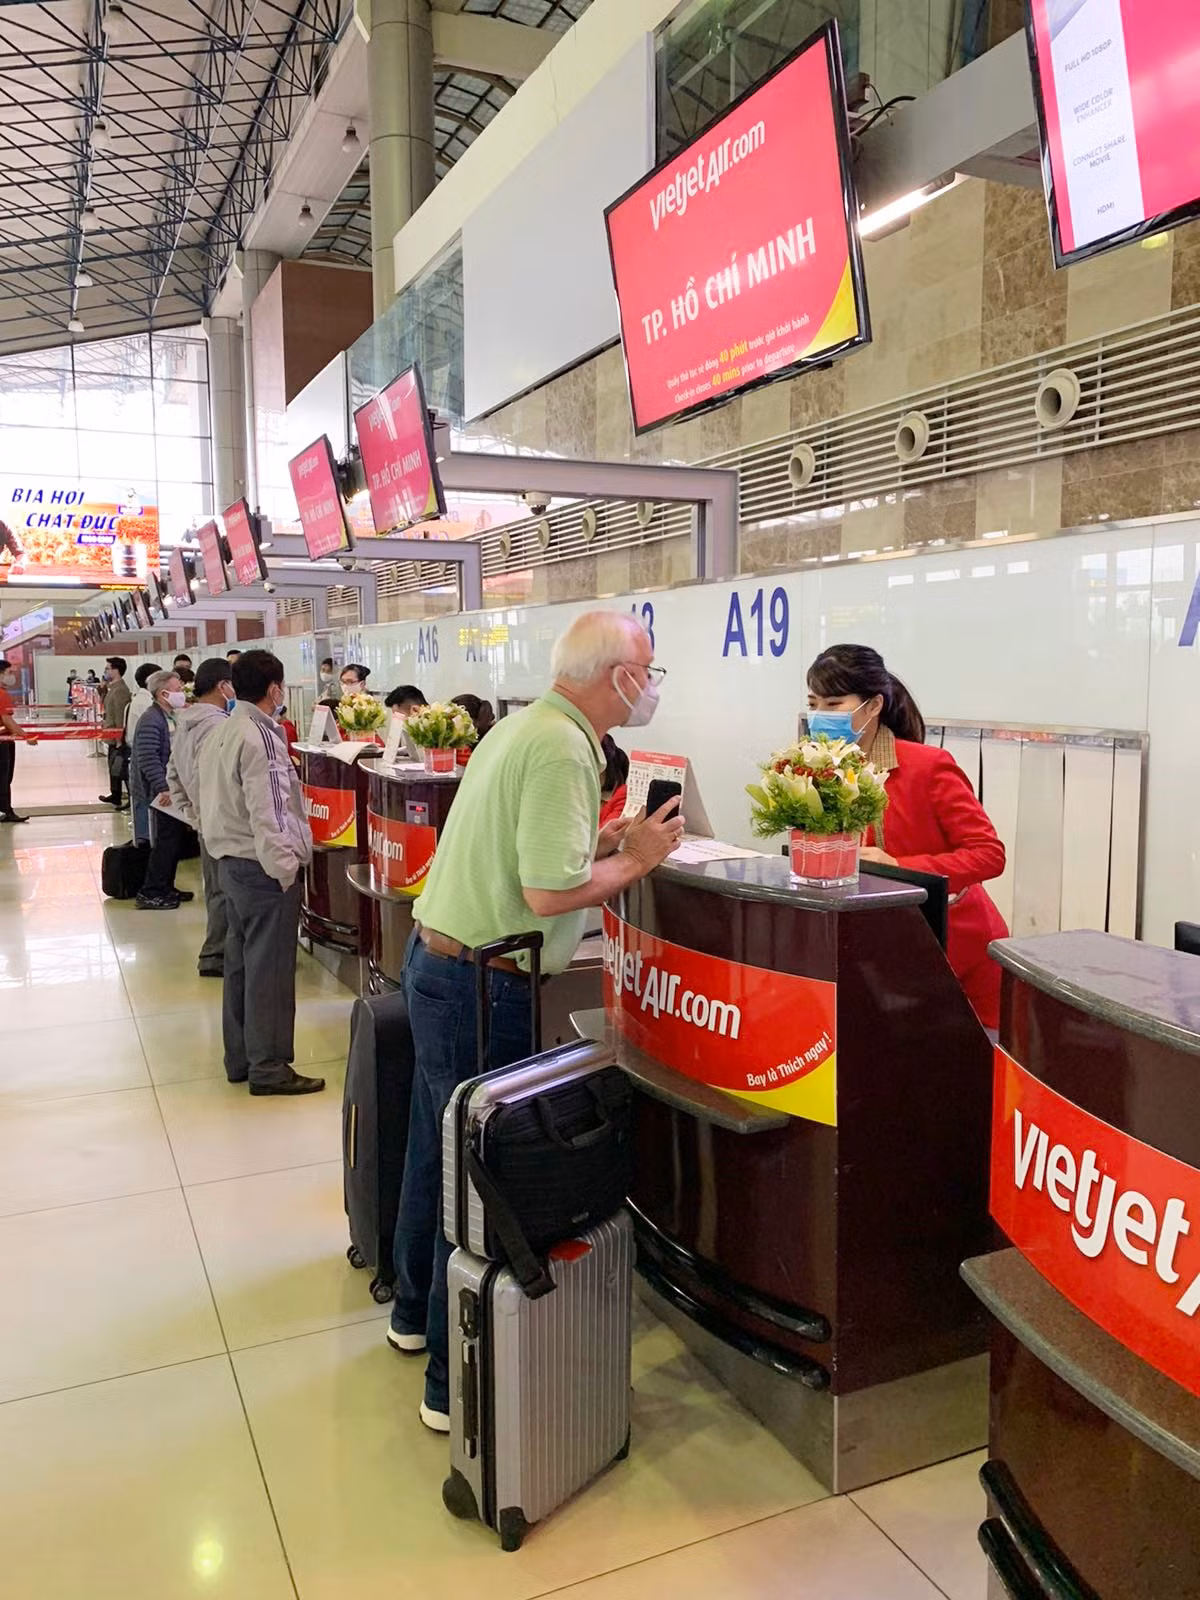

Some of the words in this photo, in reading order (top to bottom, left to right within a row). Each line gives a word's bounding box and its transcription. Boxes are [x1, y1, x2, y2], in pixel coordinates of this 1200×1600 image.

[1097, 201, 1115, 215] HDMI
[641, 308, 668, 345] TP.
[704, 251, 741, 310] CHÍ
[747, 217, 817, 289] MINH
[719, 348, 729, 363] 40
[711, 372, 721, 386] 40
[722, 366, 740, 383] mins
[11, 487, 44, 503] BIA
[722, 586, 789, 658] A19
[418, 625, 439, 664] A16
[746, 1072, 766, 1088] Bay
[767, 1066, 779, 1083] là
[777, 1055, 806, 1079] Thích
[1014, 1107, 1200, 1317] Vietjet
